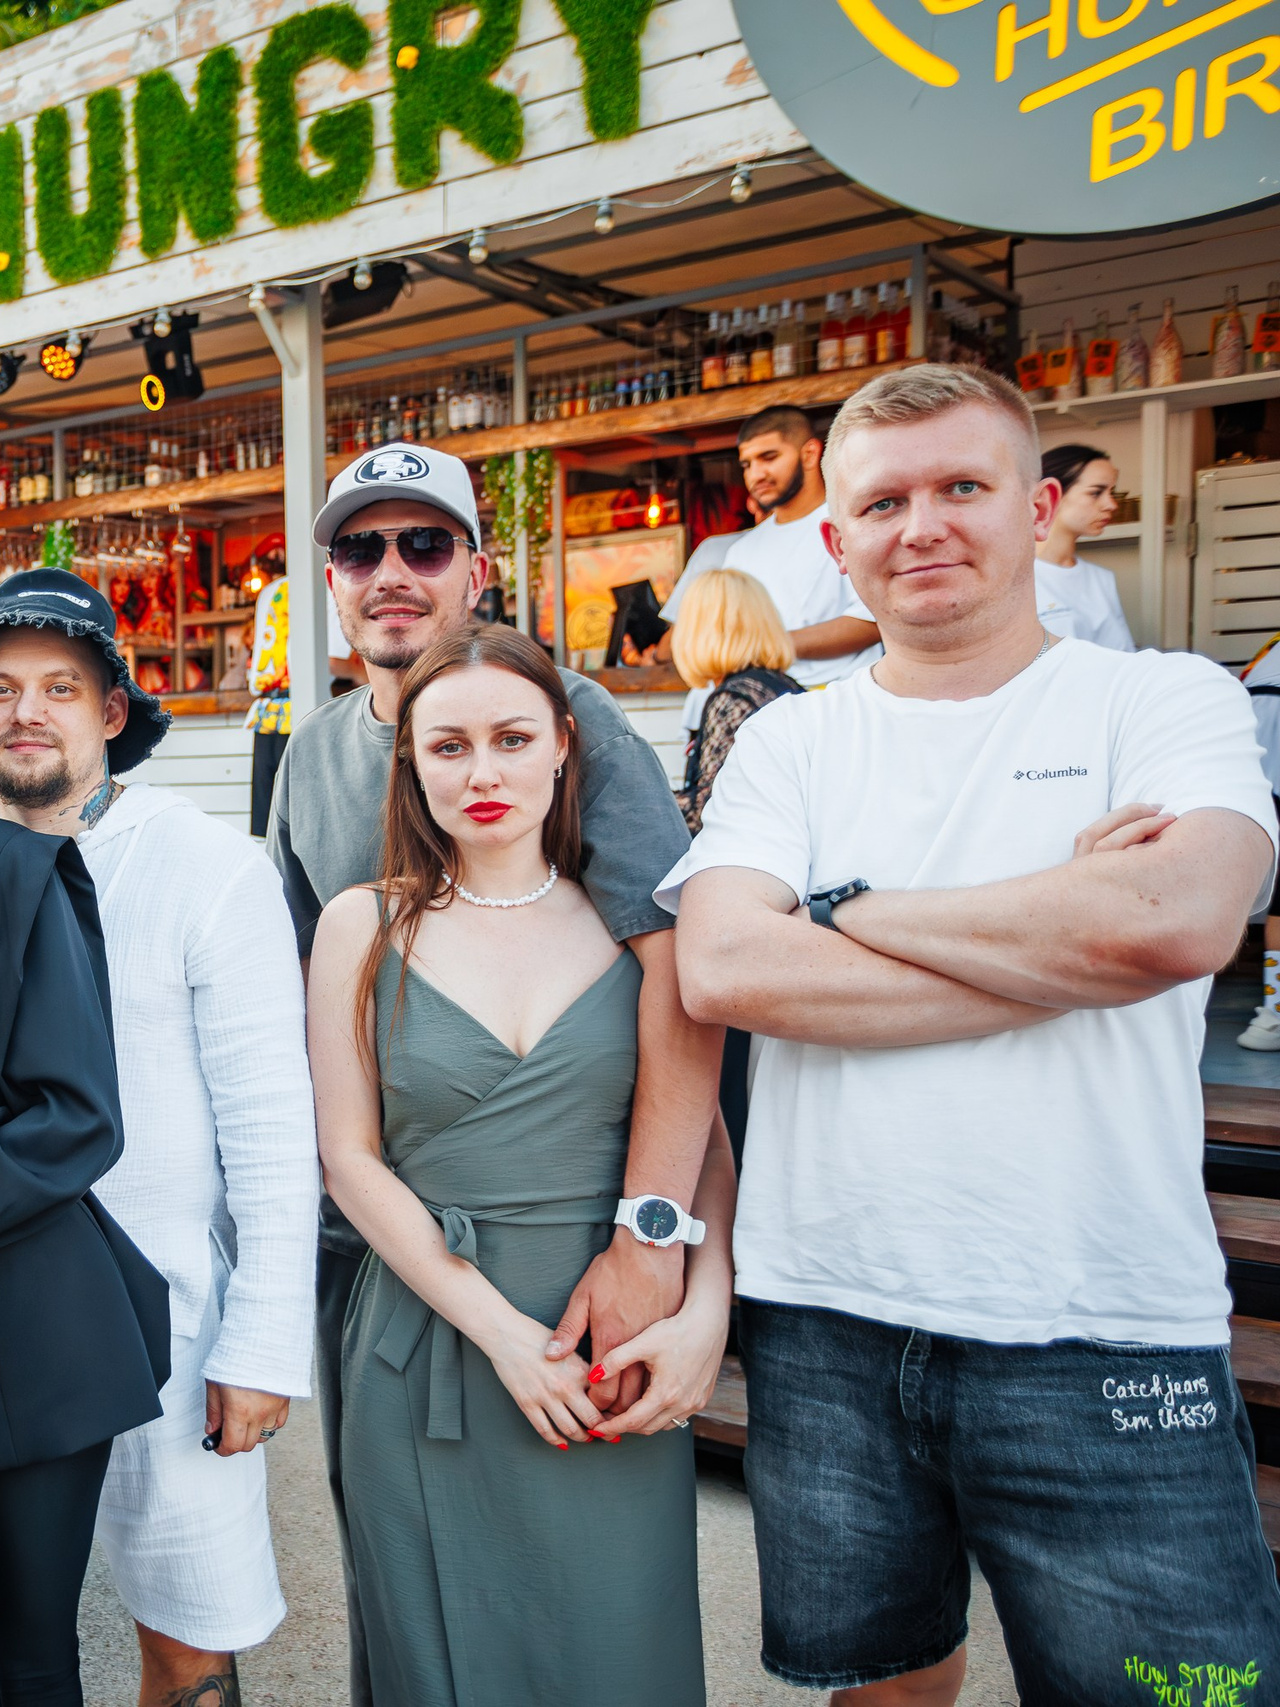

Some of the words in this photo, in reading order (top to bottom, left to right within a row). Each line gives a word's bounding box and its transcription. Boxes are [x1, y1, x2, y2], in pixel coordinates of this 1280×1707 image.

[1026, 765, 1088, 781] Columbia
[1124, 1656, 1168, 1684] HOW
[1178, 1660, 1262, 1689] STRONG
[1153, 1684, 1191, 1707] YOU
[1202, 1684, 1247, 1707] ARE
